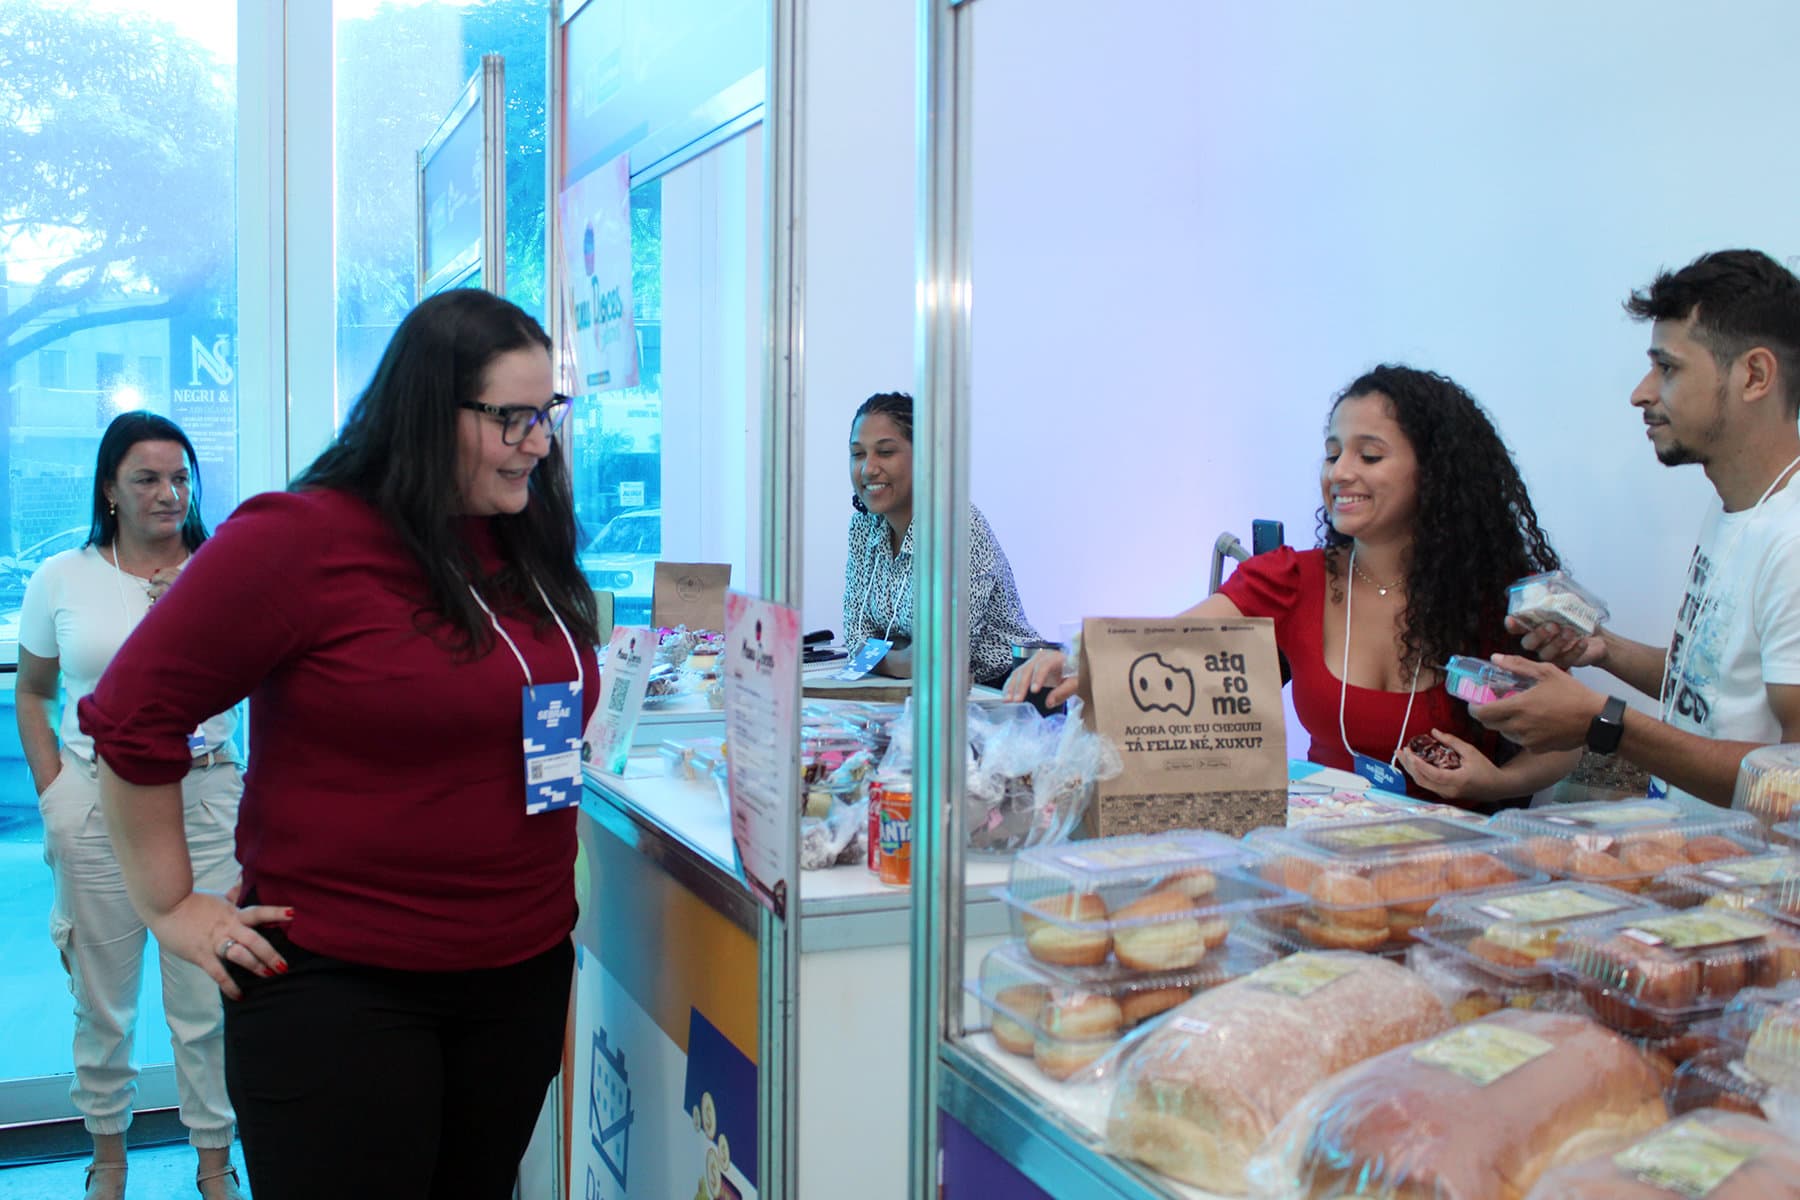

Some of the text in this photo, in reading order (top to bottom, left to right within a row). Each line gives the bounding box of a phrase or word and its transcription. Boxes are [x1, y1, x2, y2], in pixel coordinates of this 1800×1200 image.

[173, 389, 230, 403] NEGRI &
[1204, 650, 1245, 674] aiq
[1212, 696, 1251, 715] me
[1125, 722, 1262, 736] AGORA QUE EU CHEGUEI
[1125, 735, 1263, 752] TÁ FELIZ NÉ, XUXU?
